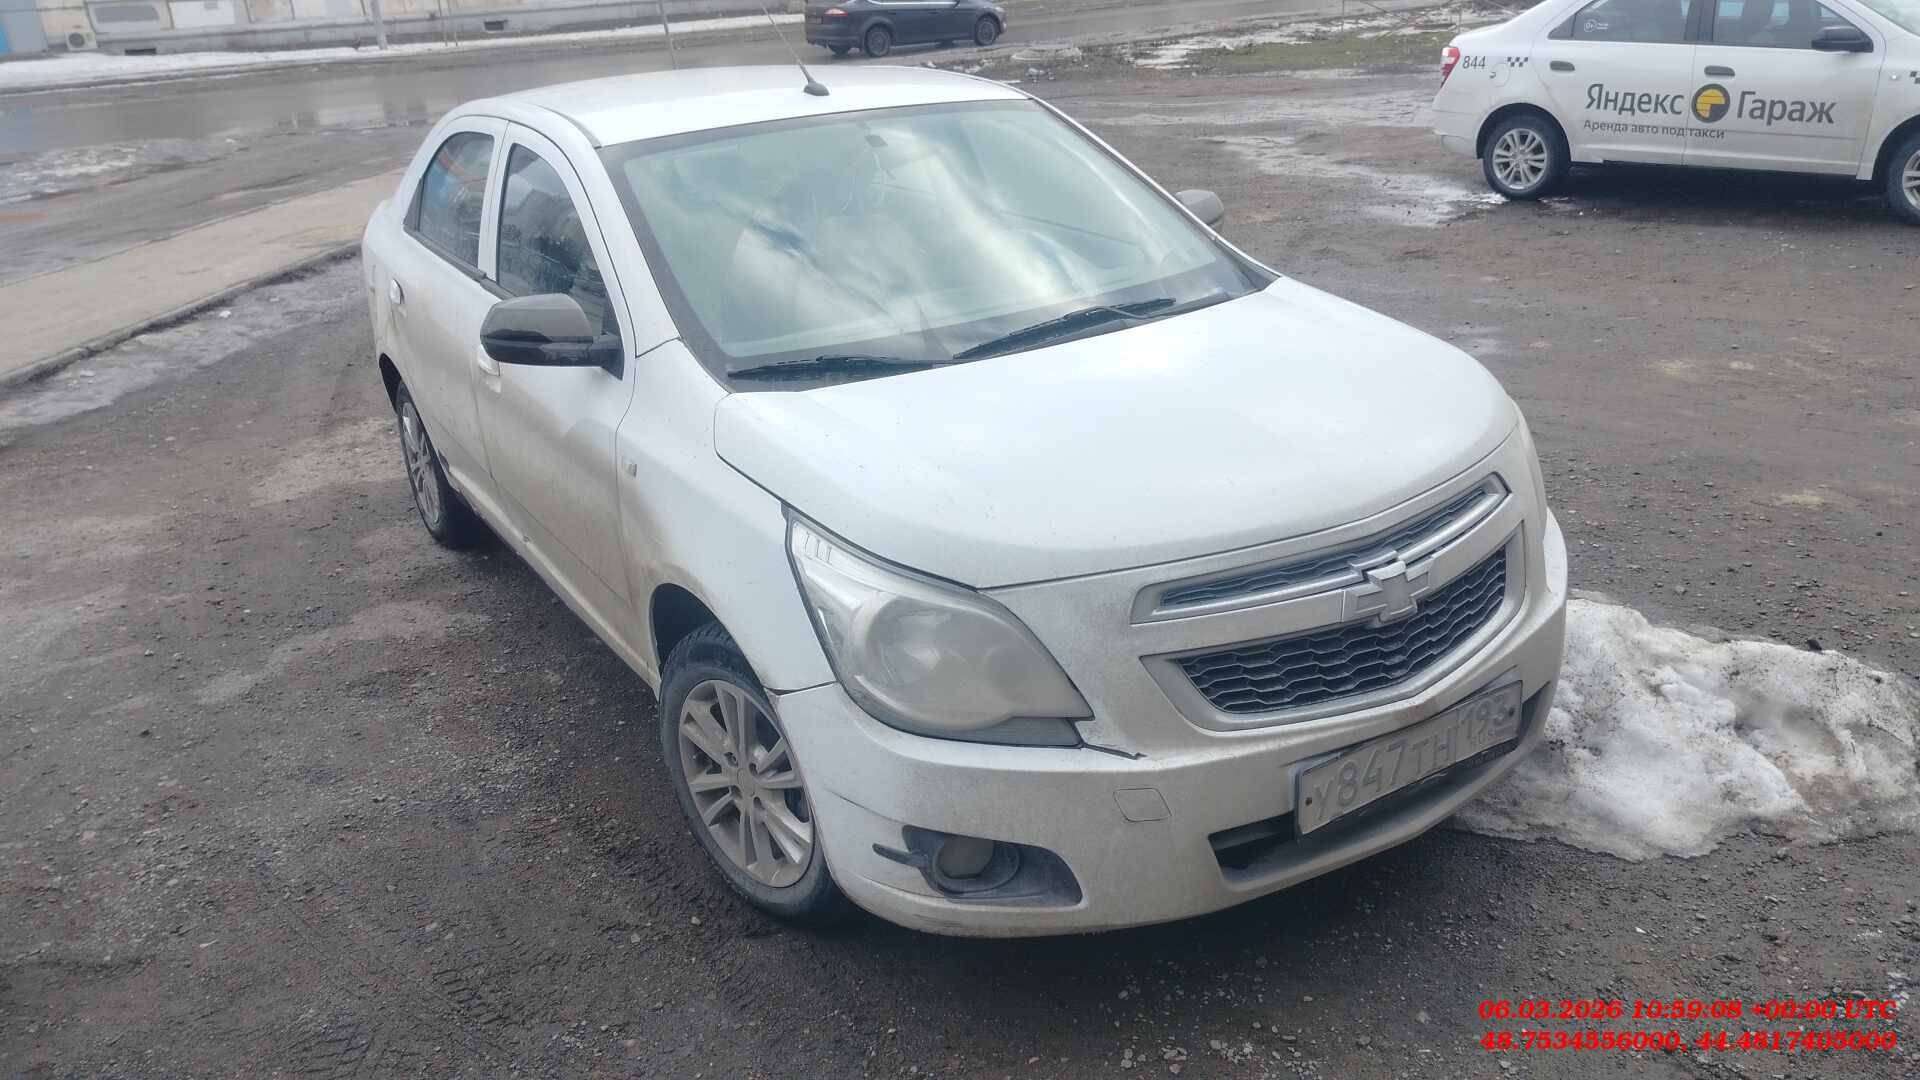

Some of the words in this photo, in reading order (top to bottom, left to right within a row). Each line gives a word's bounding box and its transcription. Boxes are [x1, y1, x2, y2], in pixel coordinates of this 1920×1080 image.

[1462, 55, 1486, 69] 844
[1584, 83, 1684, 116] Яндекс
[1736, 90, 1838, 125] Гараж
[1583, 119, 1629, 132] Аренда
[1631, 122, 1660, 135] авто
[1661, 126, 1685, 137] под
[1686, 127, 1725, 139] такси
